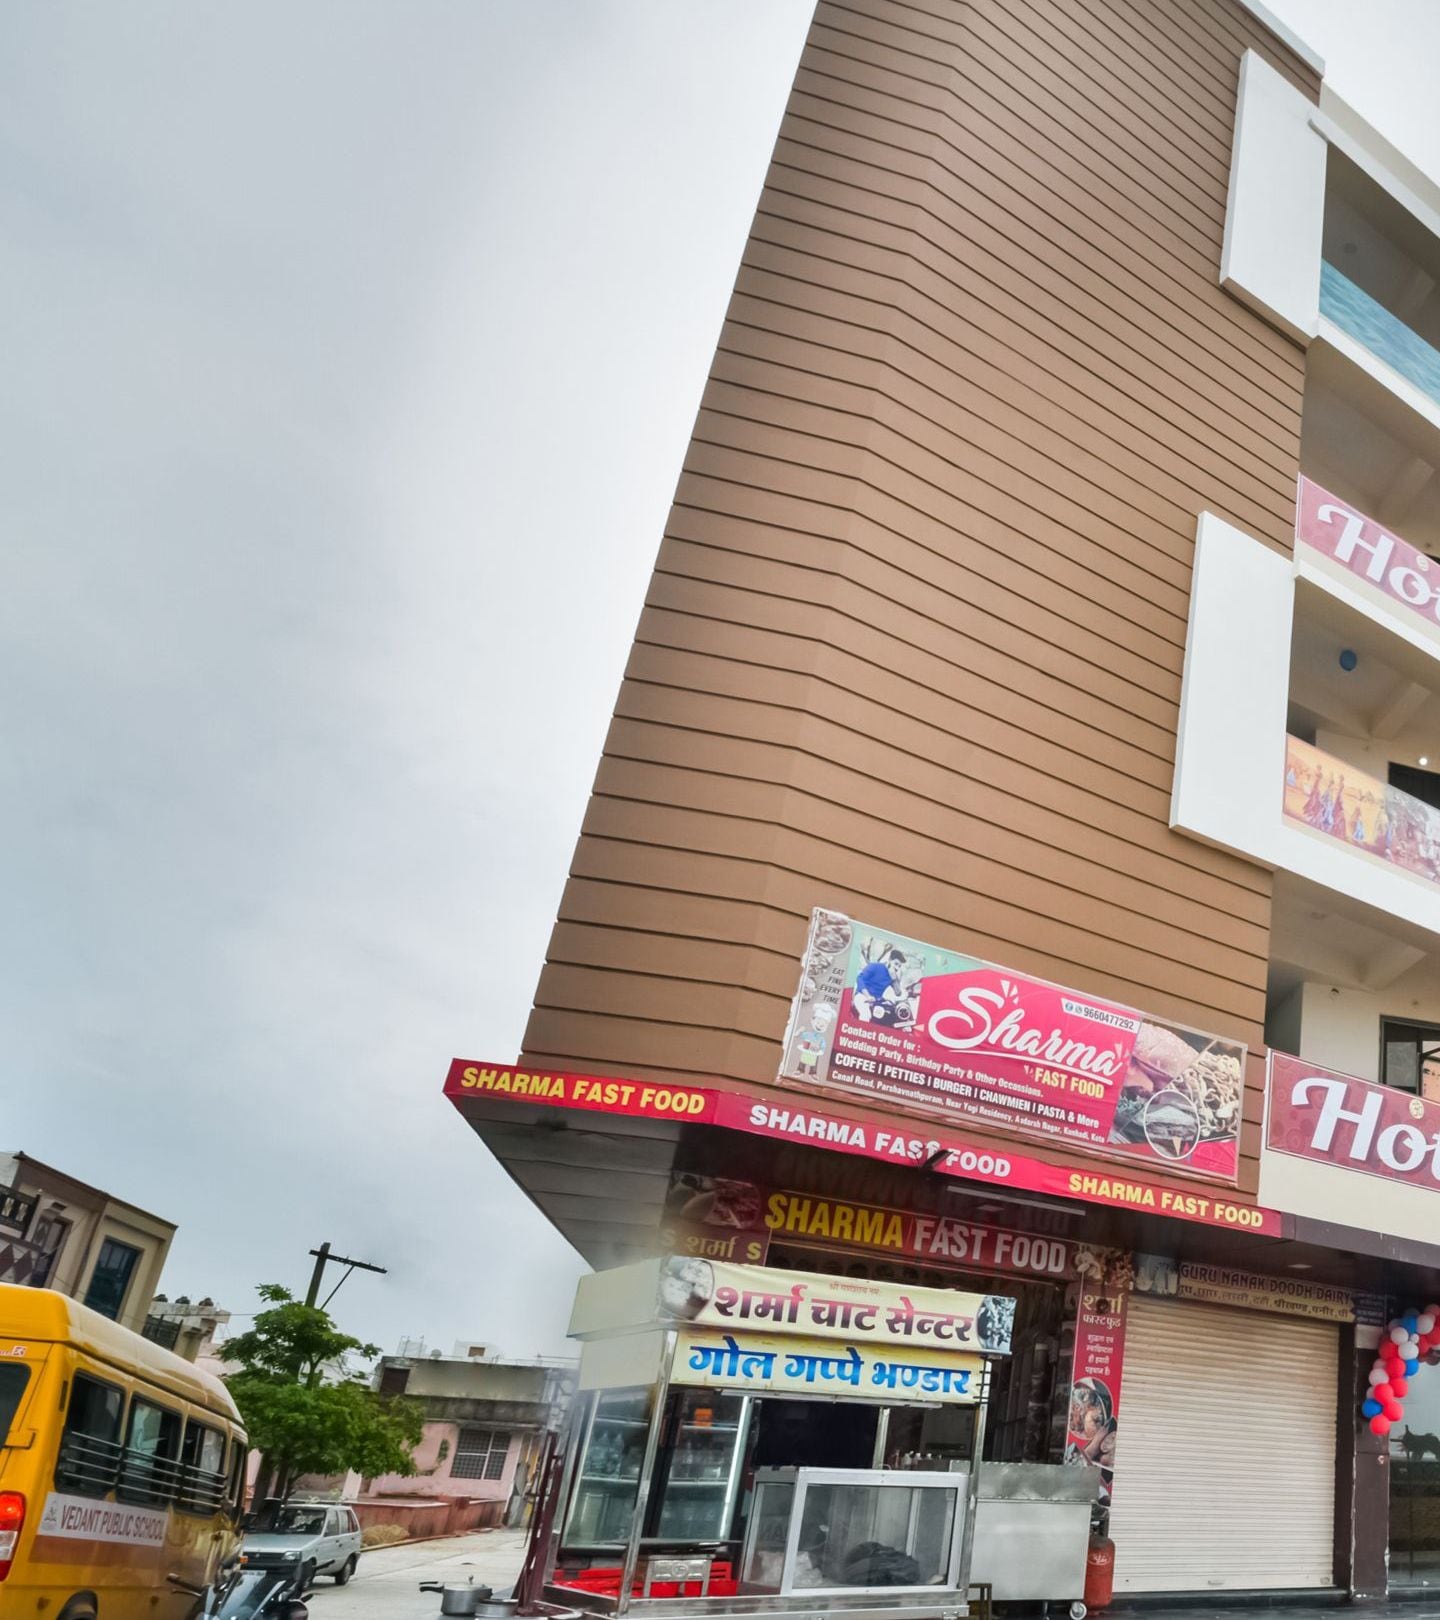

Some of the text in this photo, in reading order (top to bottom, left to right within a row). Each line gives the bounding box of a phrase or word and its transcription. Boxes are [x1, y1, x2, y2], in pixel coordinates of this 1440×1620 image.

[841, 1023, 876, 1041] Contact
[878, 1032, 900, 1047] Order
[903, 1038, 916, 1050] for
[928, 987, 1124, 1076] Sharma
[1083, 1006, 1135, 1030] 9660477292
[839, 1036, 877, 1056] Wedding
[879, 1047, 904, 1063] Party,
[906, 1053, 942, 1073] Birthday
[943, 1063, 965, 1079] Party
[966, 1069, 973, 1079] &
[975, 1071, 997, 1085] Other
[1034, 1066, 1105, 1099] FAST FOOD
[460, 1067, 706, 1114] SHARMA FAST FOOD
[831, 1070, 854, 1082] Canal
[854, 1075, 875, 1089] Road,
[963, 1102, 979, 1114] Yogi
[835, 1052, 876, 1073] COFFEE
[884, 1064, 926, 1086] PETTIES
[933, 1077, 972, 1097] BURGER
[979, 1089, 1032, 1112] CHAWMIEN
[1037, 1104, 1066, 1121] PASTA
[1067, 1111, 1075, 1123] &
[1077, 1113, 1099, 1129] More
[749, 1104, 866, 1148] SHARMA
[945, 1148, 1011, 1178] FOOD
[1068, 1173, 1263, 1228] SHARMA FAST FOOD
[686, 1235, 740, 1259] शर्मा
[764, 1193, 1067, 1274] SHARMA FAST FOOD
[1180, 1264, 1351, 1305] GURU NANAK DOODH DAIRY
[714, 1284, 974, 1342] शर्मा चाट सेन्टर
[688, 1335, 971, 1394] गोल गप्पे भण्डार
[60, 1504, 163, 1540] VEDANT PUBLIC SCHOOL
